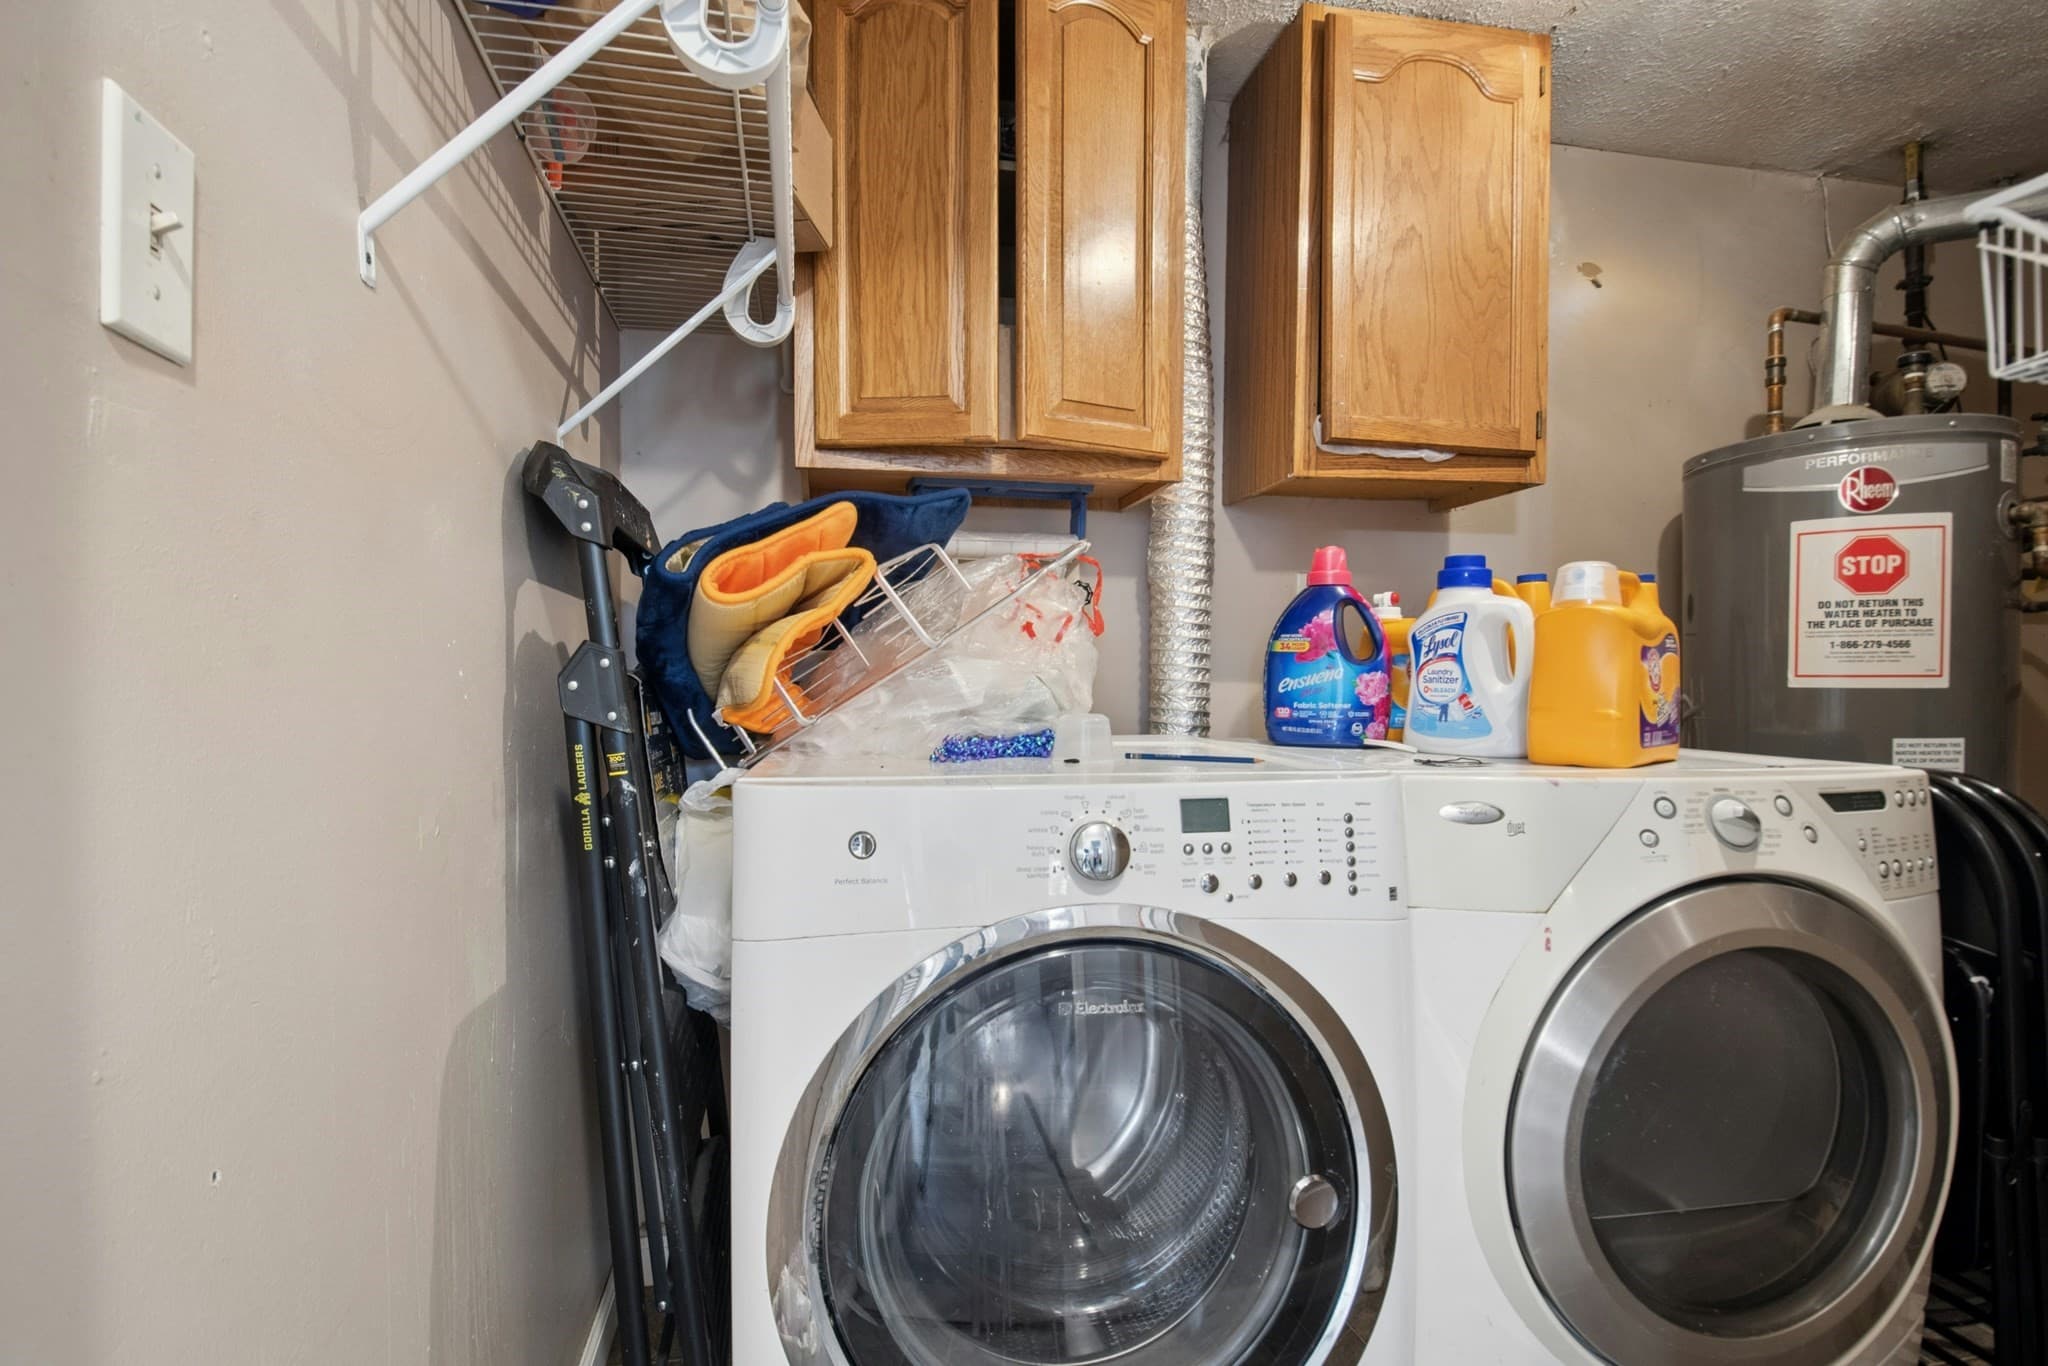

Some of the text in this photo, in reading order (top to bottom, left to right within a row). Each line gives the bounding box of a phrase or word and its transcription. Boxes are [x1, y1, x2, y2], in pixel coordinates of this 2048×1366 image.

[1846, 468, 1894, 507] Rheem
[1841, 554, 1902, 576] STOP
[1817, 598, 1924, 609] DO NOT RETURN THIS
[1824, 608, 1918, 619] WATER HEATER TO
[1807, 618, 1934, 629] THE PLACE OF PURCHASE
[1423, 630, 1459, 659] Lysol
[1427, 668, 1454, 677] Laundry
[1423, 675, 1460, 684] Sanitizer
[574, 744, 593, 850] GORILLA LADDERS
[1075, 999, 1145, 1015] Electrolux
